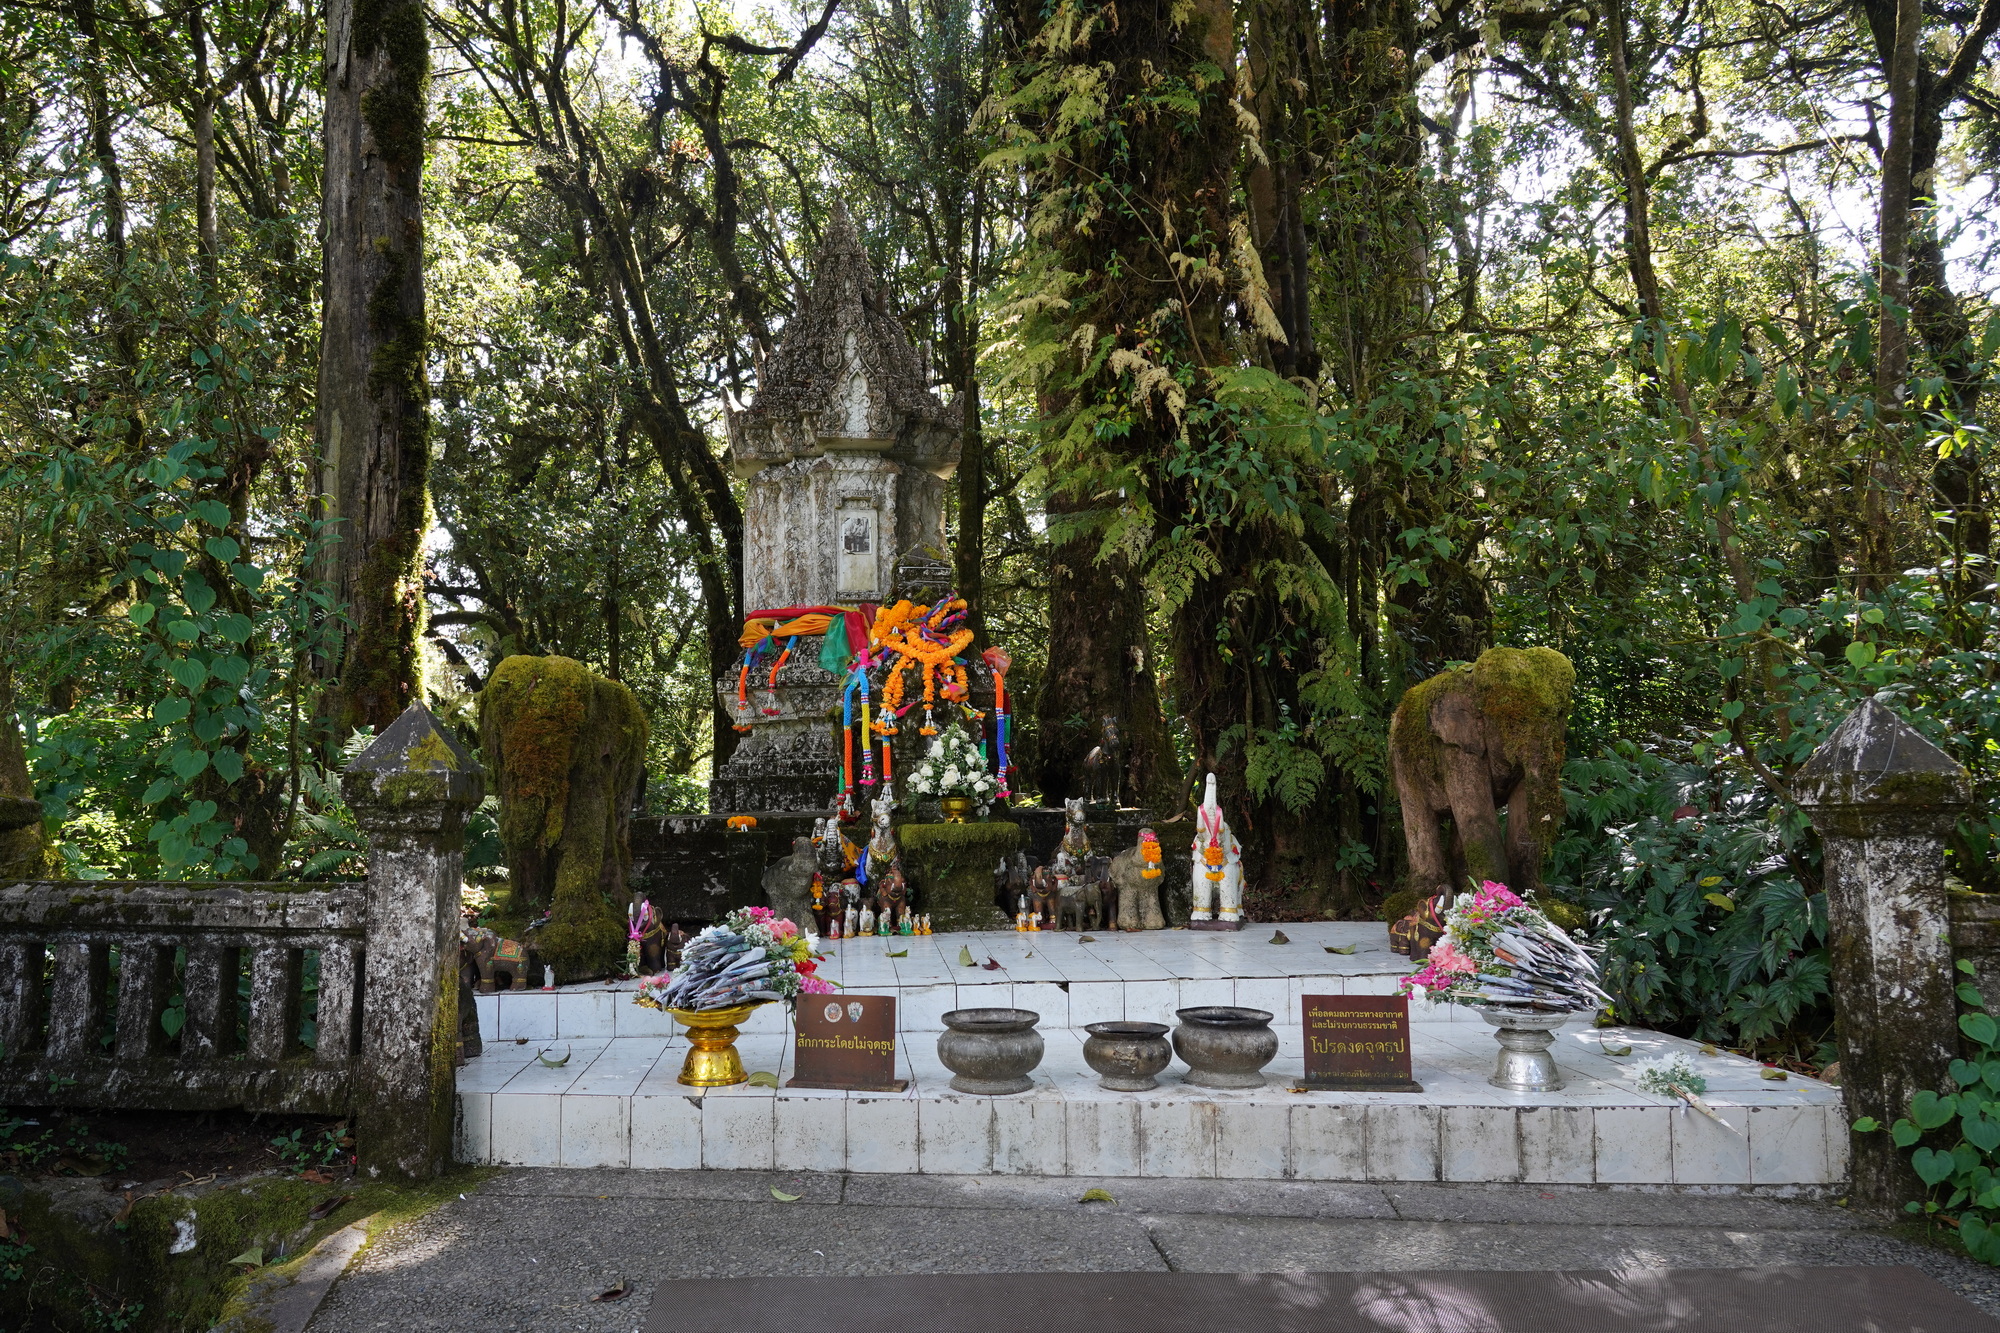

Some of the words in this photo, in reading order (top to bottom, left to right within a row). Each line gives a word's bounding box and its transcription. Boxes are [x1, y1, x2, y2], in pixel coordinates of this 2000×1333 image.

[1308, 1006, 1404, 1018] เพื่อลดมลภาวะทางอากาศ
[1312, 1020, 1398, 1030] และไม่รบกวนธรรมชาติ
[797, 1032, 895, 1056] สักการะโดยไม่จุดธูป
[1310, 1036, 1405, 1061] โปรดงดจุดธูป
